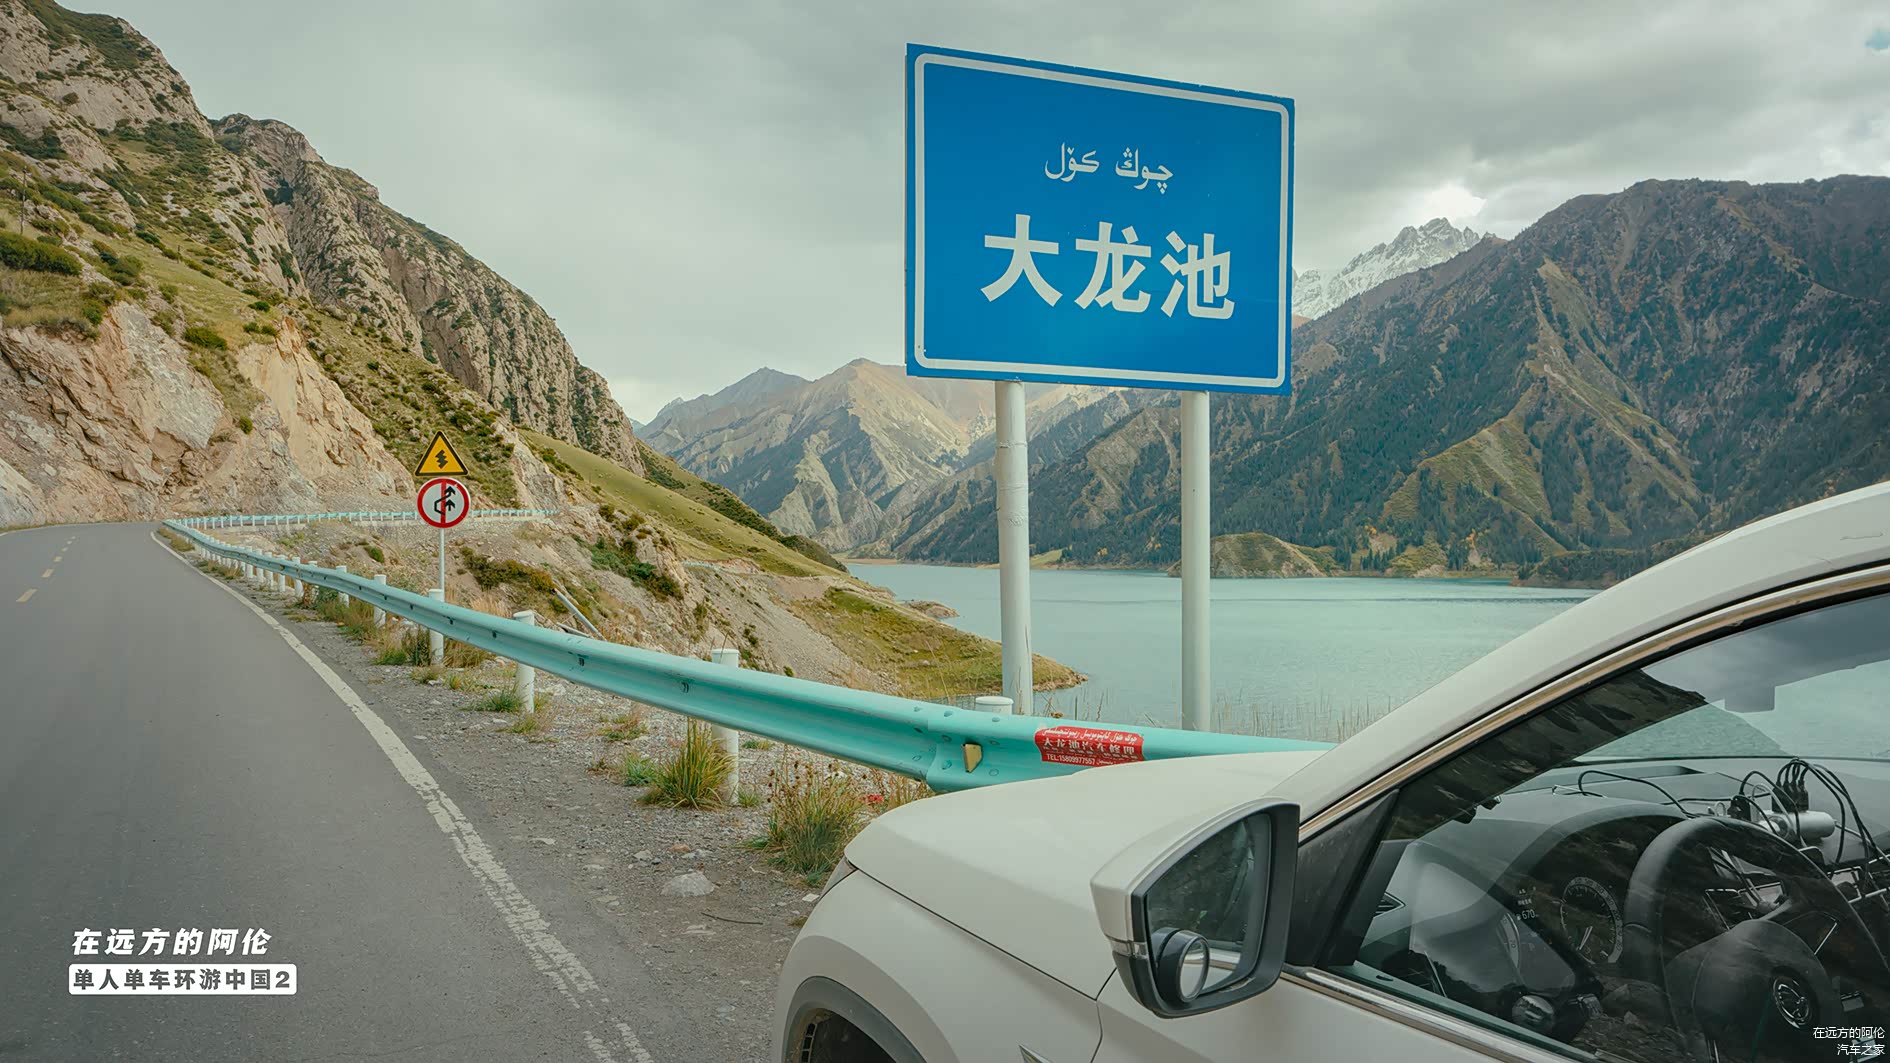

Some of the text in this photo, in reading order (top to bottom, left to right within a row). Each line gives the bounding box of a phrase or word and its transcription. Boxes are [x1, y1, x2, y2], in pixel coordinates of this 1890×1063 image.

[1044, 142, 1174, 194] چوڭ كۆل
[980, 213, 1235, 320] 大龙池
